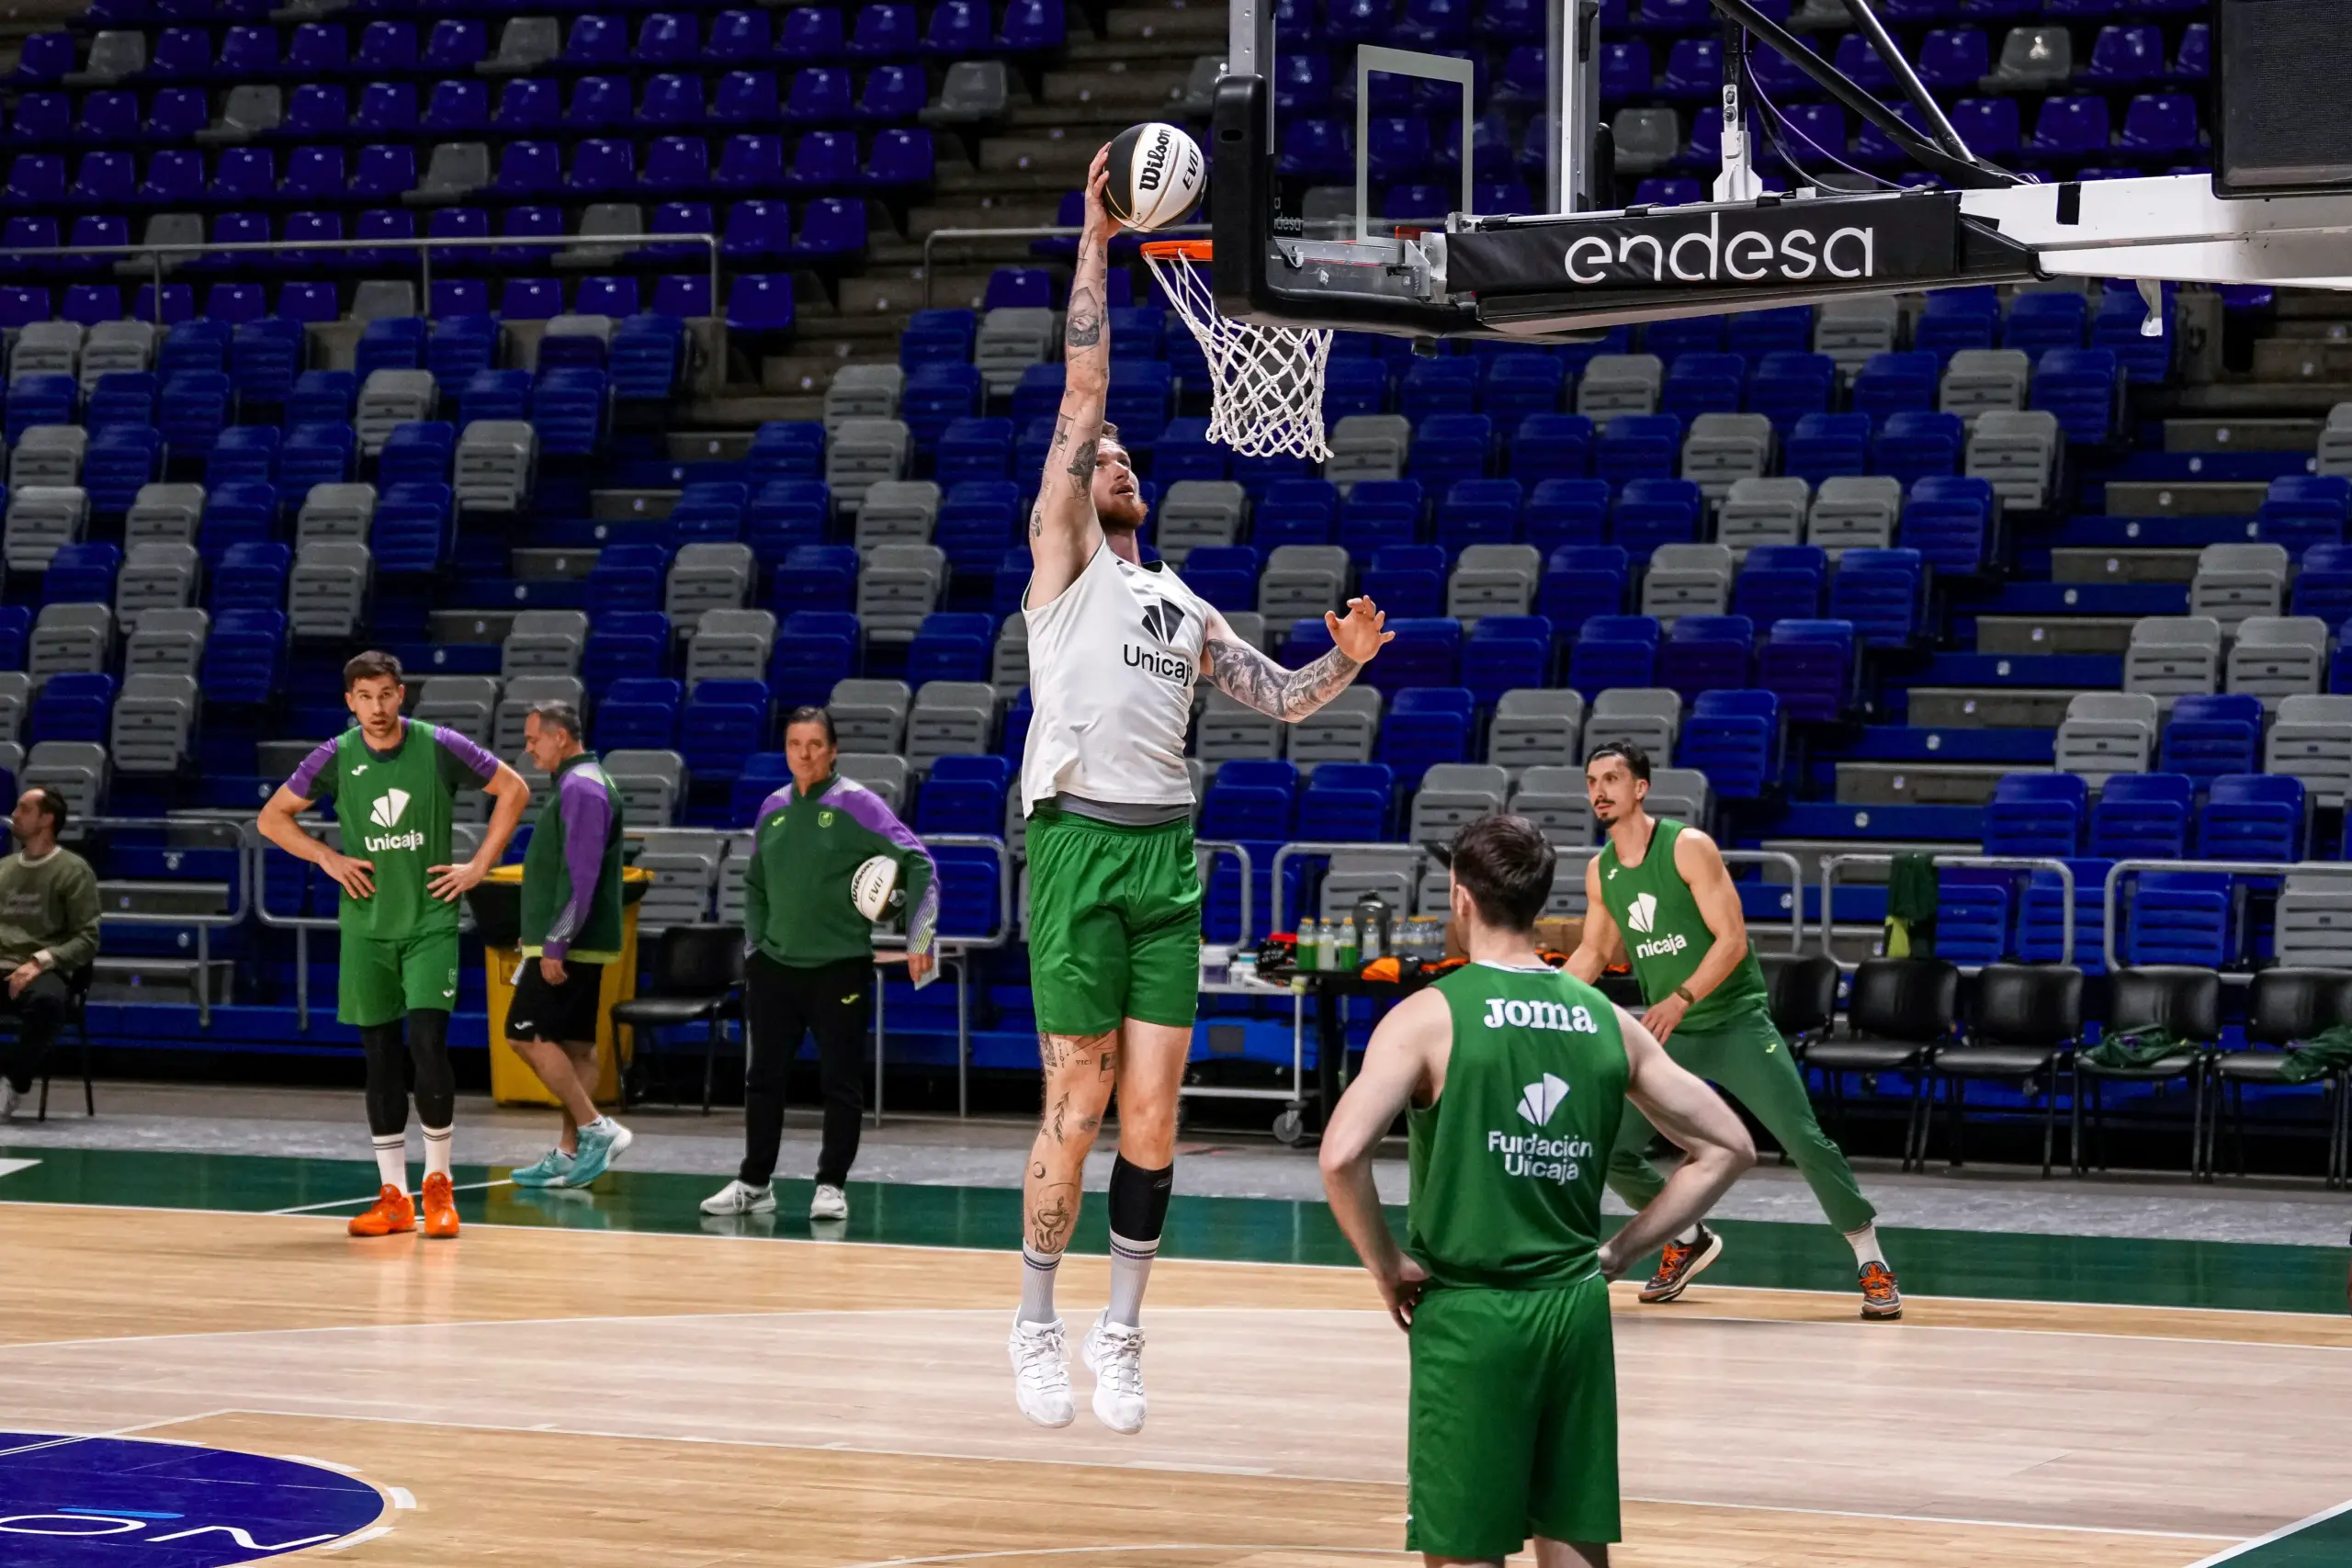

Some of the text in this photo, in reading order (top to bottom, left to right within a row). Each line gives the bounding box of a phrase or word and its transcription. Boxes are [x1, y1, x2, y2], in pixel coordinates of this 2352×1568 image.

[1139, 129, 1171, 190] Wilson
[1564, 211, 1874, 284] endesa
[1635, 933, 1688, 958] nicaja
[1484, 998, 1598, 1033] Joma
